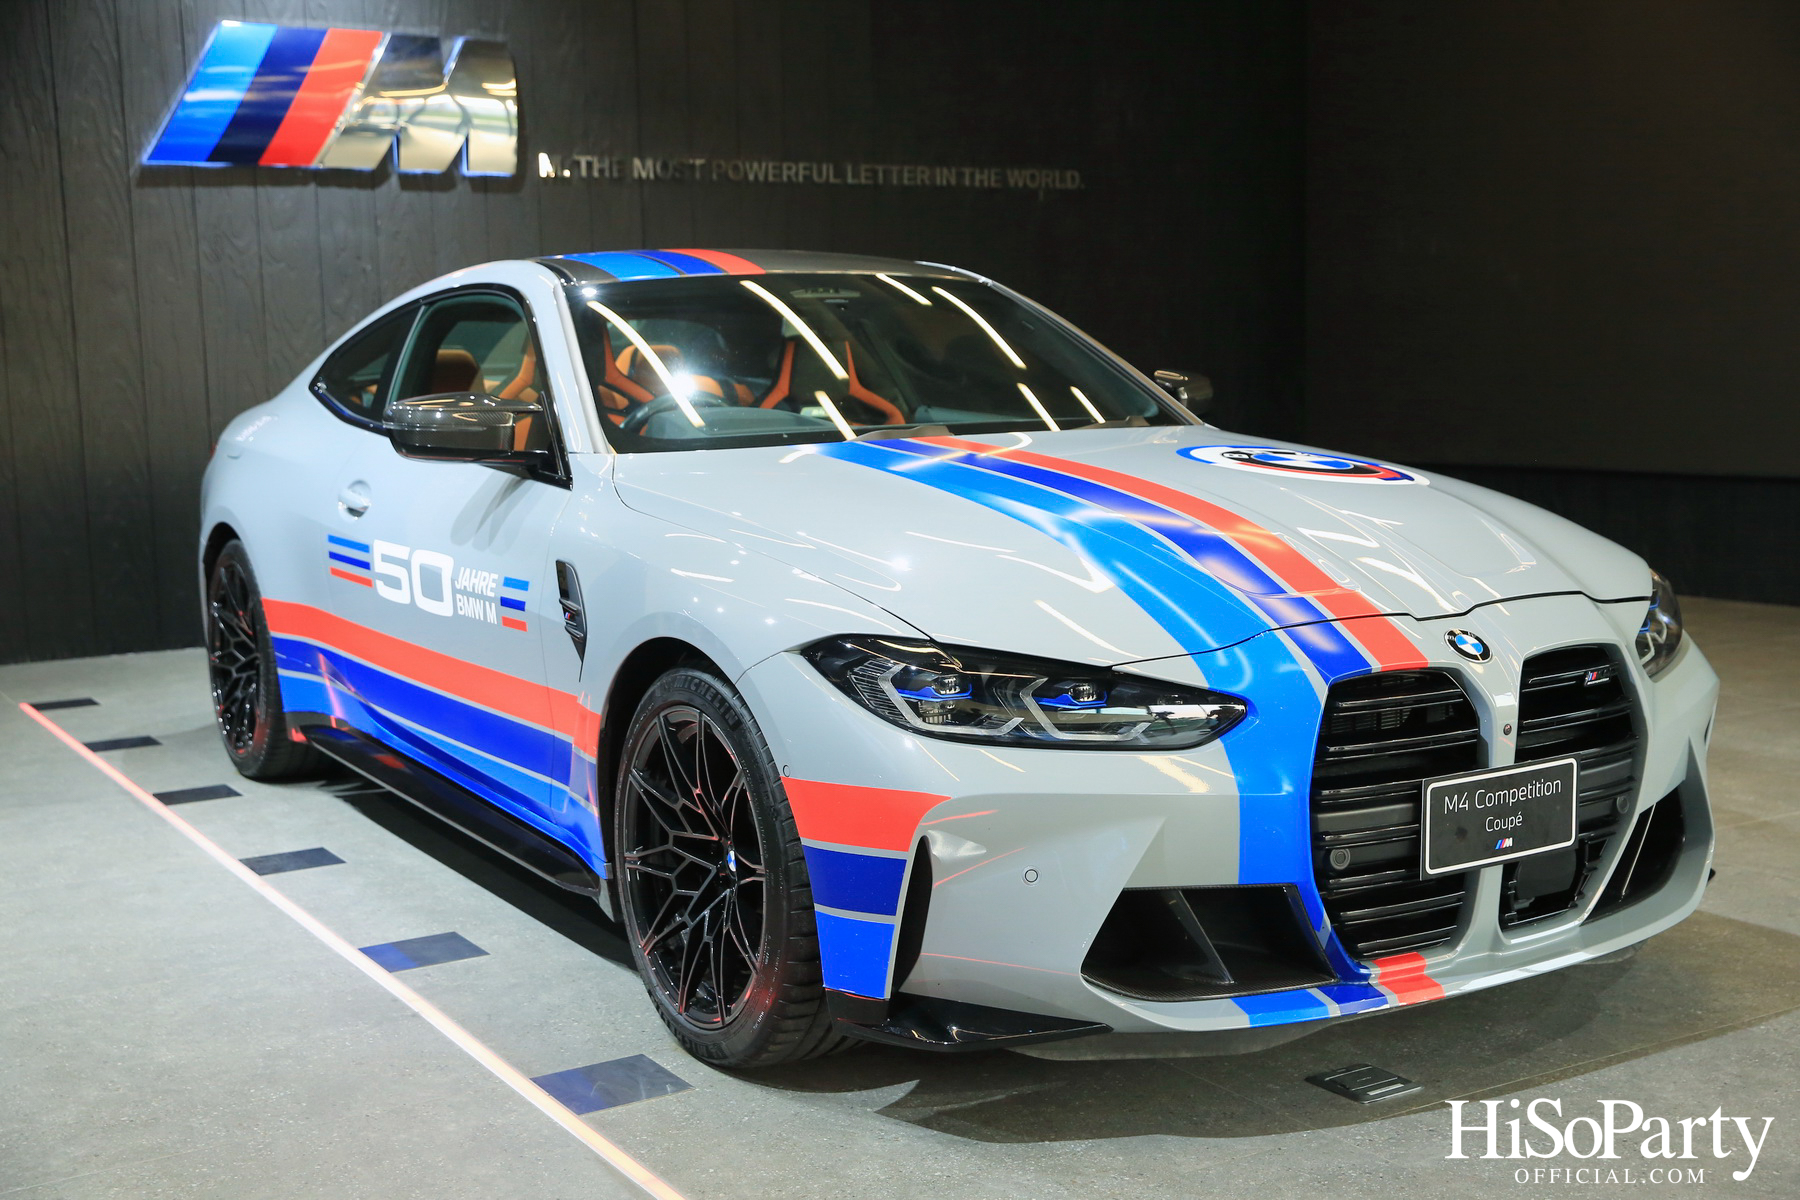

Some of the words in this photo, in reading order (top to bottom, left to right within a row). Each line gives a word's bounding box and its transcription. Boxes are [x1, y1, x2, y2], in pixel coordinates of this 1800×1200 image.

[574, 155, 621, 179] THE
[632, 157, 706, 181] MOST
[712, 160, 842, 184] POWERFUL
[847, 164, 930, 187] LETTER
[935, 166, 956, 186] IN
[959, 167, 1001, 188] THE
[1006, 169, 1086, 190] WORLD.
[373, 539, 454, 617] 50
[455, 567, 498, 597] JAHRE
[456, 593, 484, 622] BMW
[485, 602, 498, 624] M
[674, 675, 739, 726] MICHELIN
[1444, 792, 1469, 814] M4
[1475, 778, 1562, 809] Competition
[1485, 811, 1523, 832] Coupé
